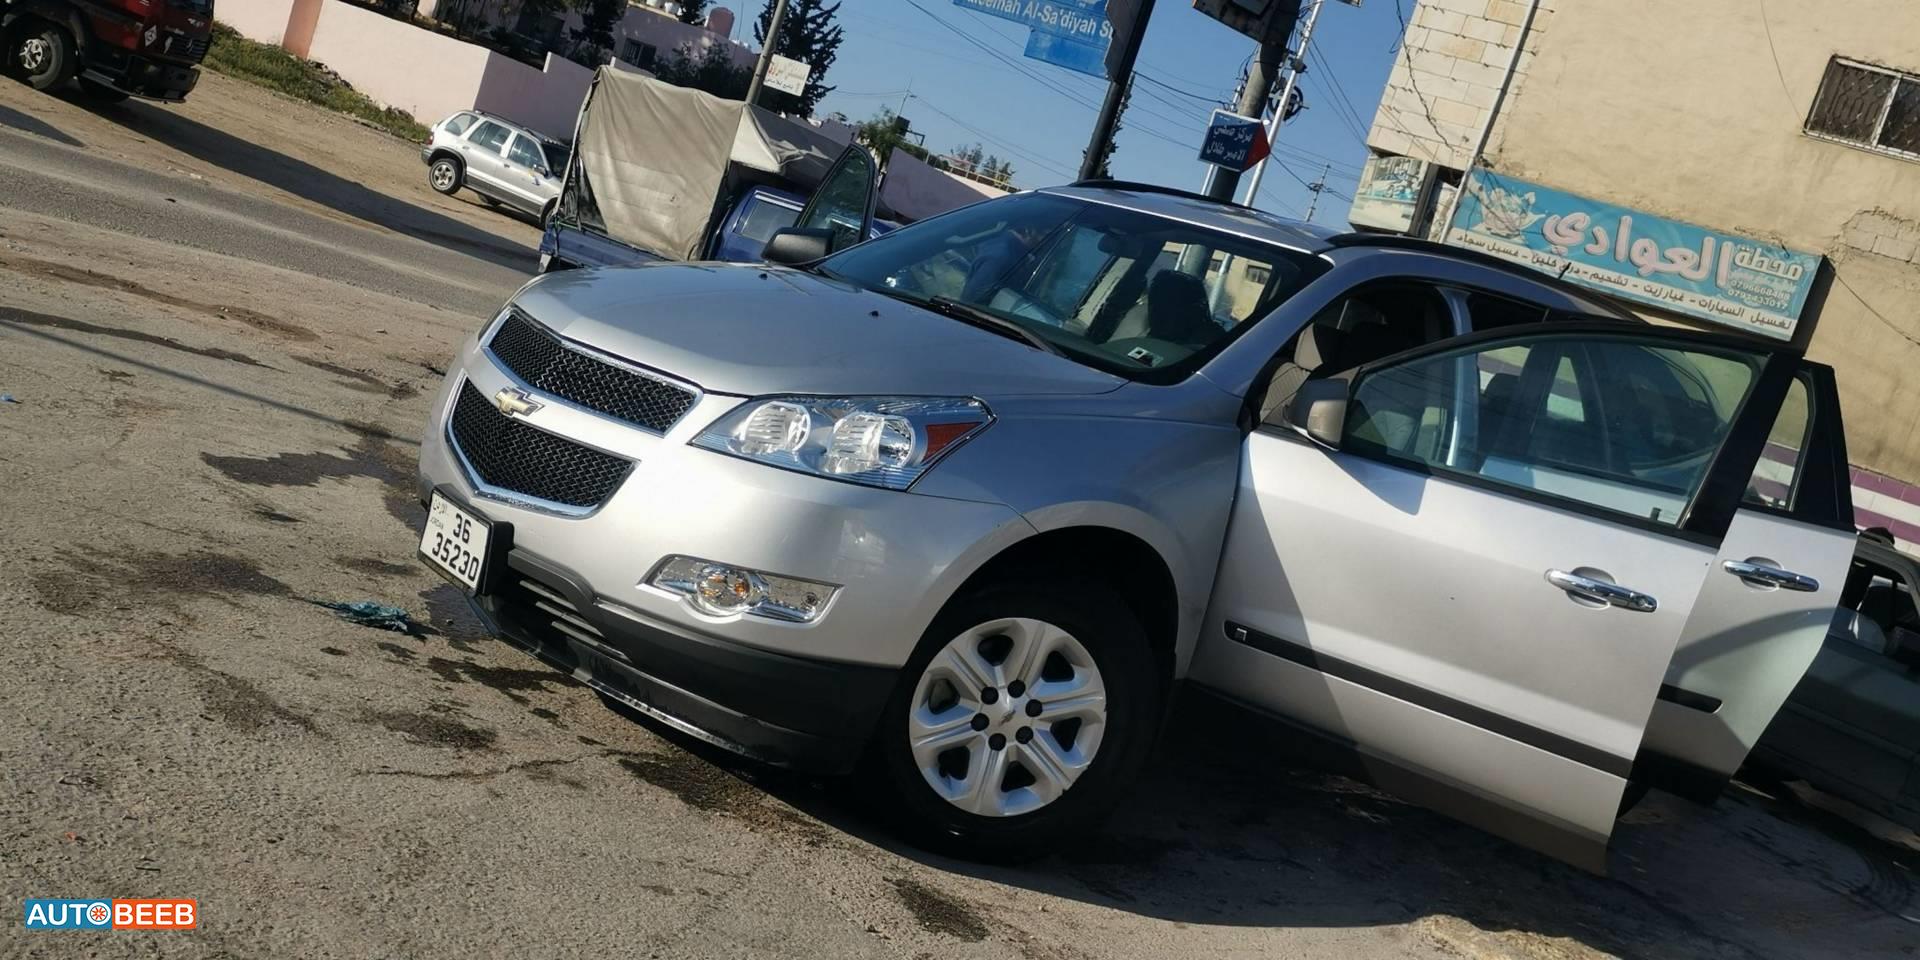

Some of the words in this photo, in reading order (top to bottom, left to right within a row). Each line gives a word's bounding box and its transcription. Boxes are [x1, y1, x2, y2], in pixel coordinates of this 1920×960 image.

[1022, 1, 1097, 34] Al-Sa'diyah
[1457, 234, 1485, 248] سجاد
[1487, 243, 1519, 257] غسيل
[1542, 211, 1735, 288] العوادي
[1734, 244, 1804, 281] محطة
[1589, 273, 1629, 287] تشحيم
[1699, 296, 1744, 317] السيارات
[453, 513, 471, 544] 36
[432, 532, 479, 582] 35230
